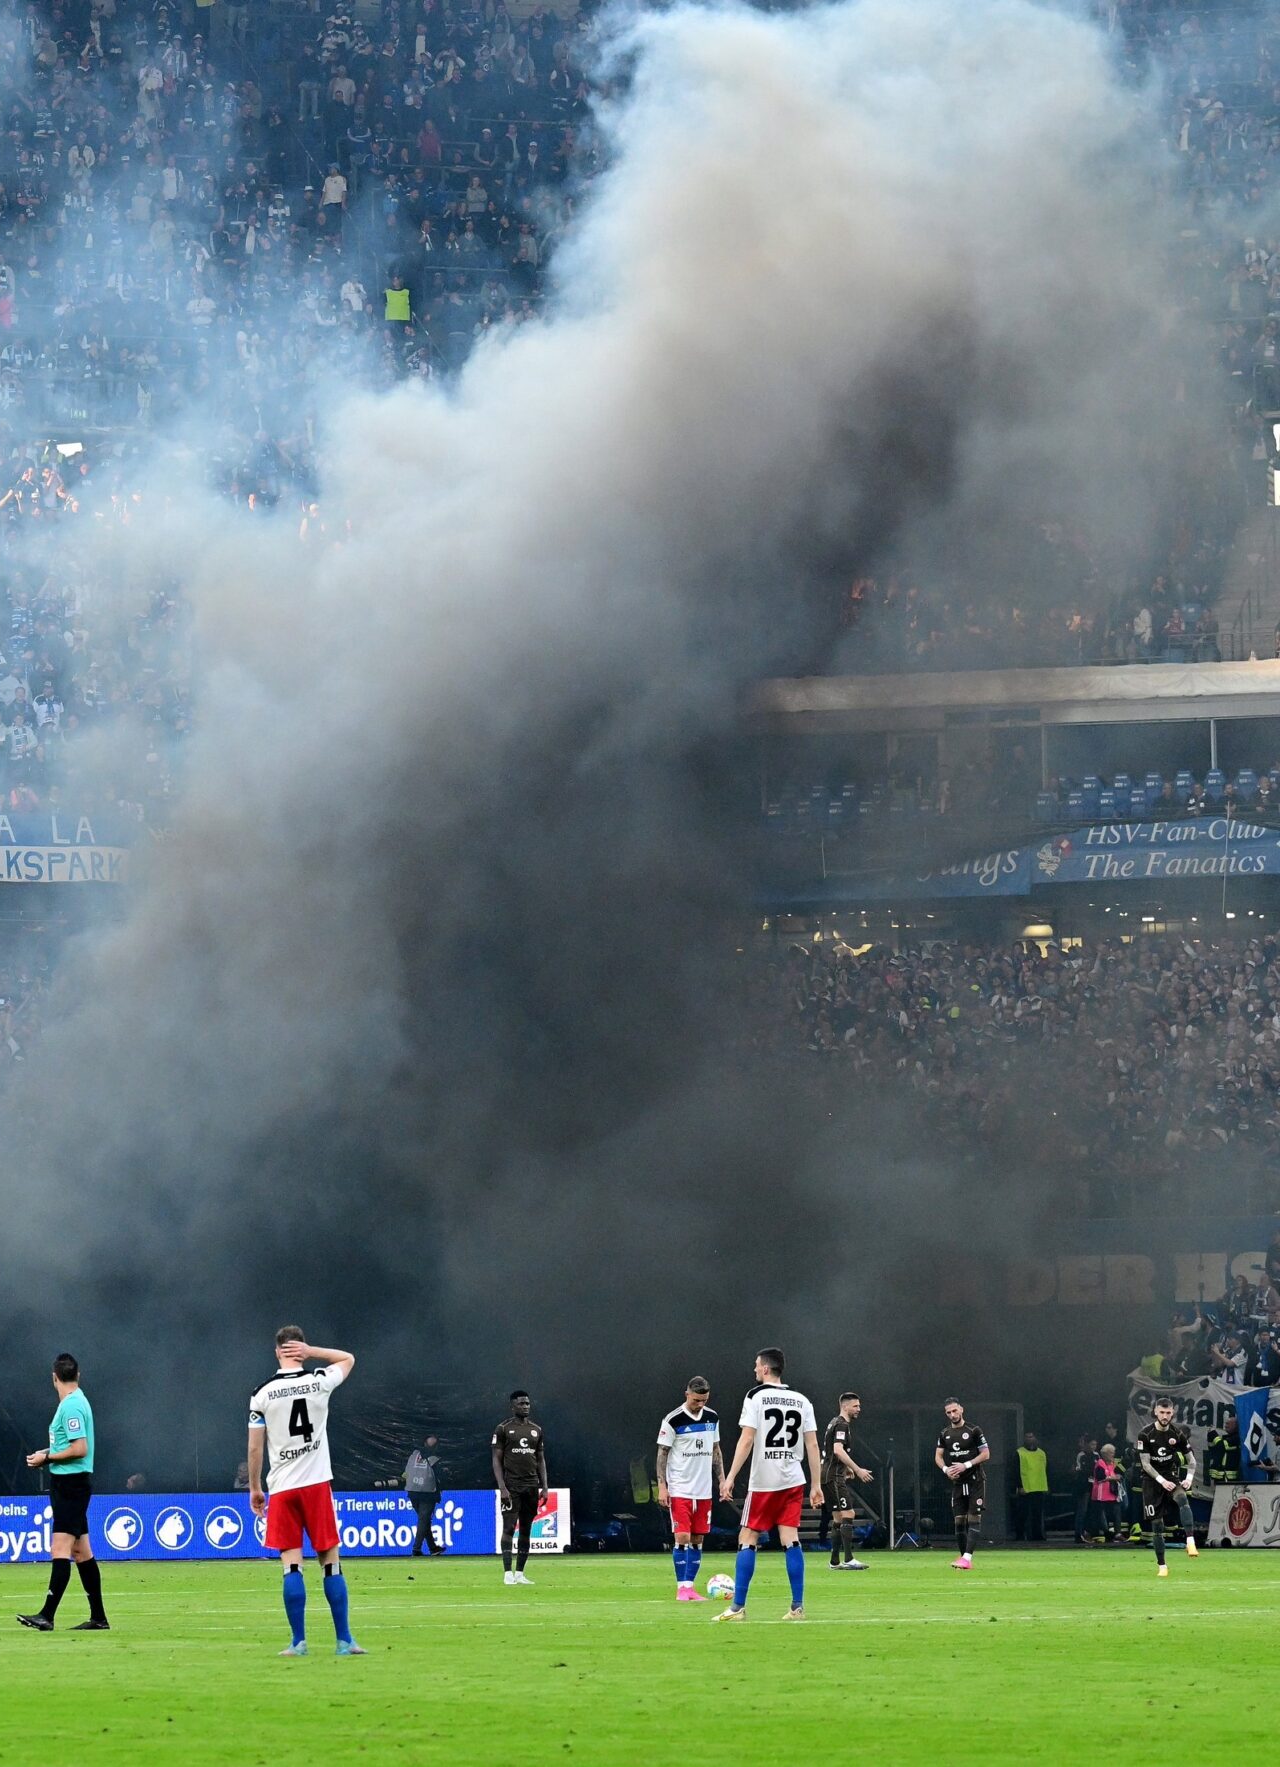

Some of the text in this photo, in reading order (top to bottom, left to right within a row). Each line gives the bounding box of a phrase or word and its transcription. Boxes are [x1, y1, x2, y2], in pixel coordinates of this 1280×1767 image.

[52, 815, 95, 844] LA
[917, 849, 1019, 887] ungs
[1085, 851, 1267, 878] The Fanatics
[268, 1382, 320, 1400] HAMBURGER SV
[762, 1397, 796, 1407] HAMBURGER
[288, 1397, 314, 1443] 4
[764, 1408, 801, 1448] 23
[347, 1499, 373, 1511] Tiere
[376, 1498, 395, 1511] wie
[840, 1498, 847, 1508] 3
[1144, 1504, 1155, 1517] 10
